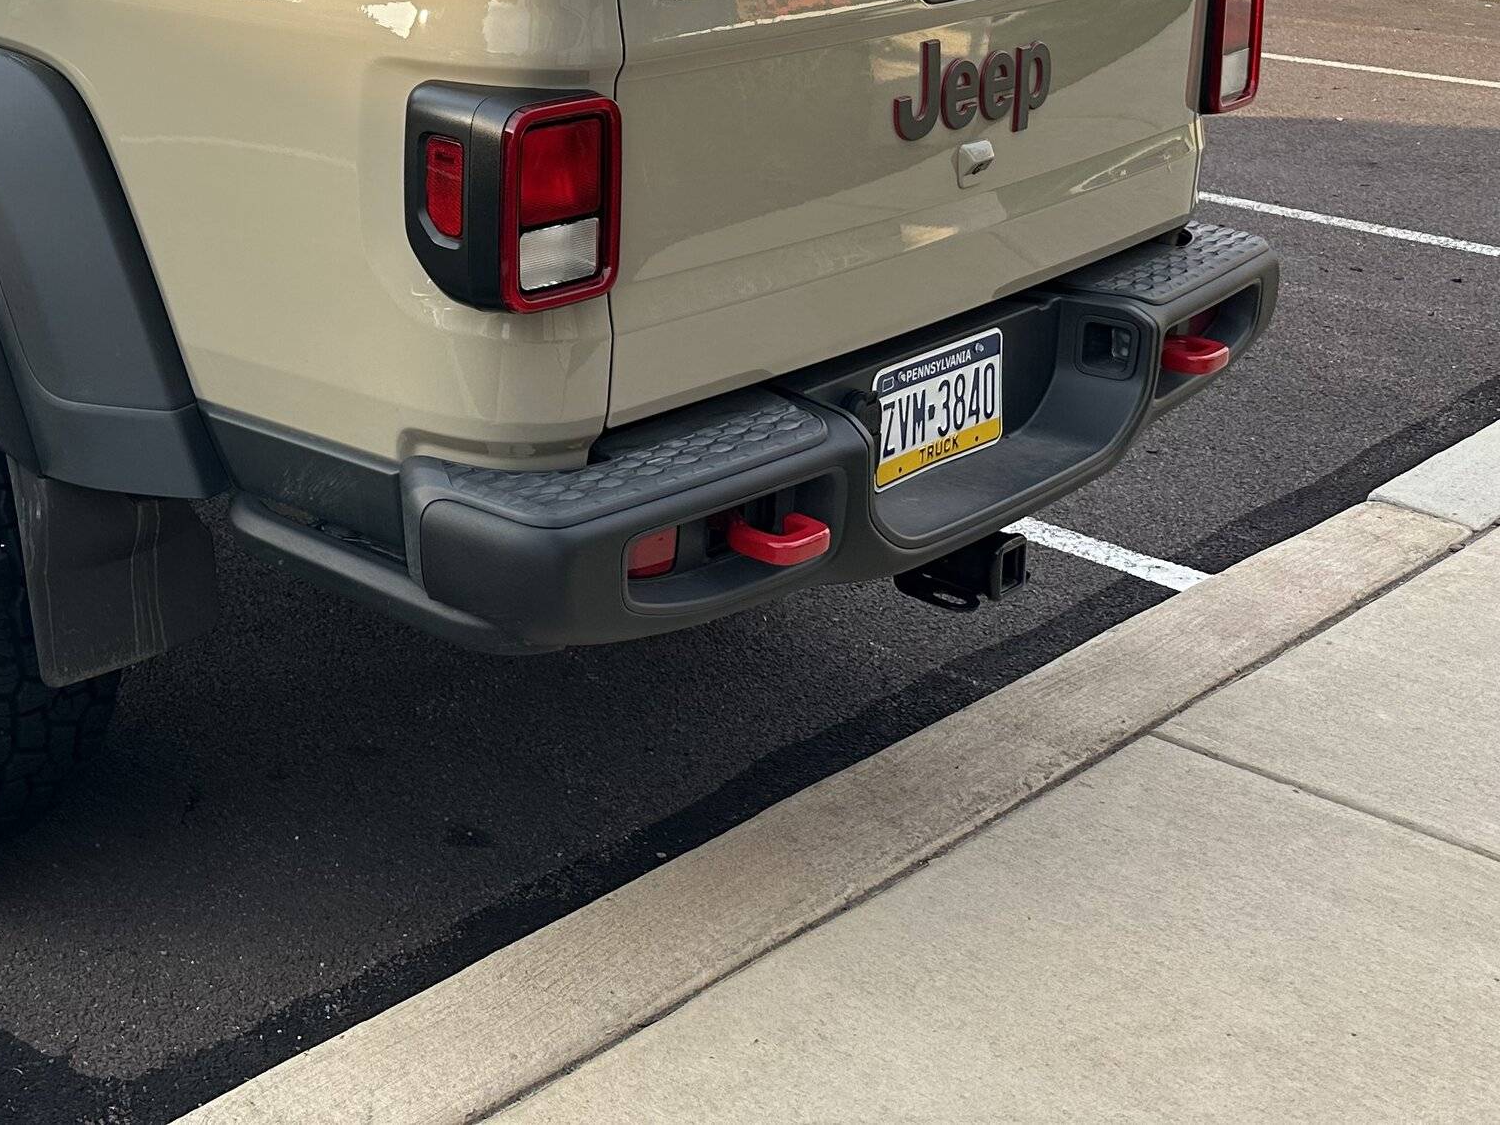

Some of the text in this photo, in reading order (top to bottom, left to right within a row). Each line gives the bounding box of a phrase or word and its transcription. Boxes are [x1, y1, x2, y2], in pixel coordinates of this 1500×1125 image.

[892, 38, 1052, 142] Jeep
[905, 348, 972, 383] PENNSYLVANIA
[918, 435, 960, 464] TRUCK
